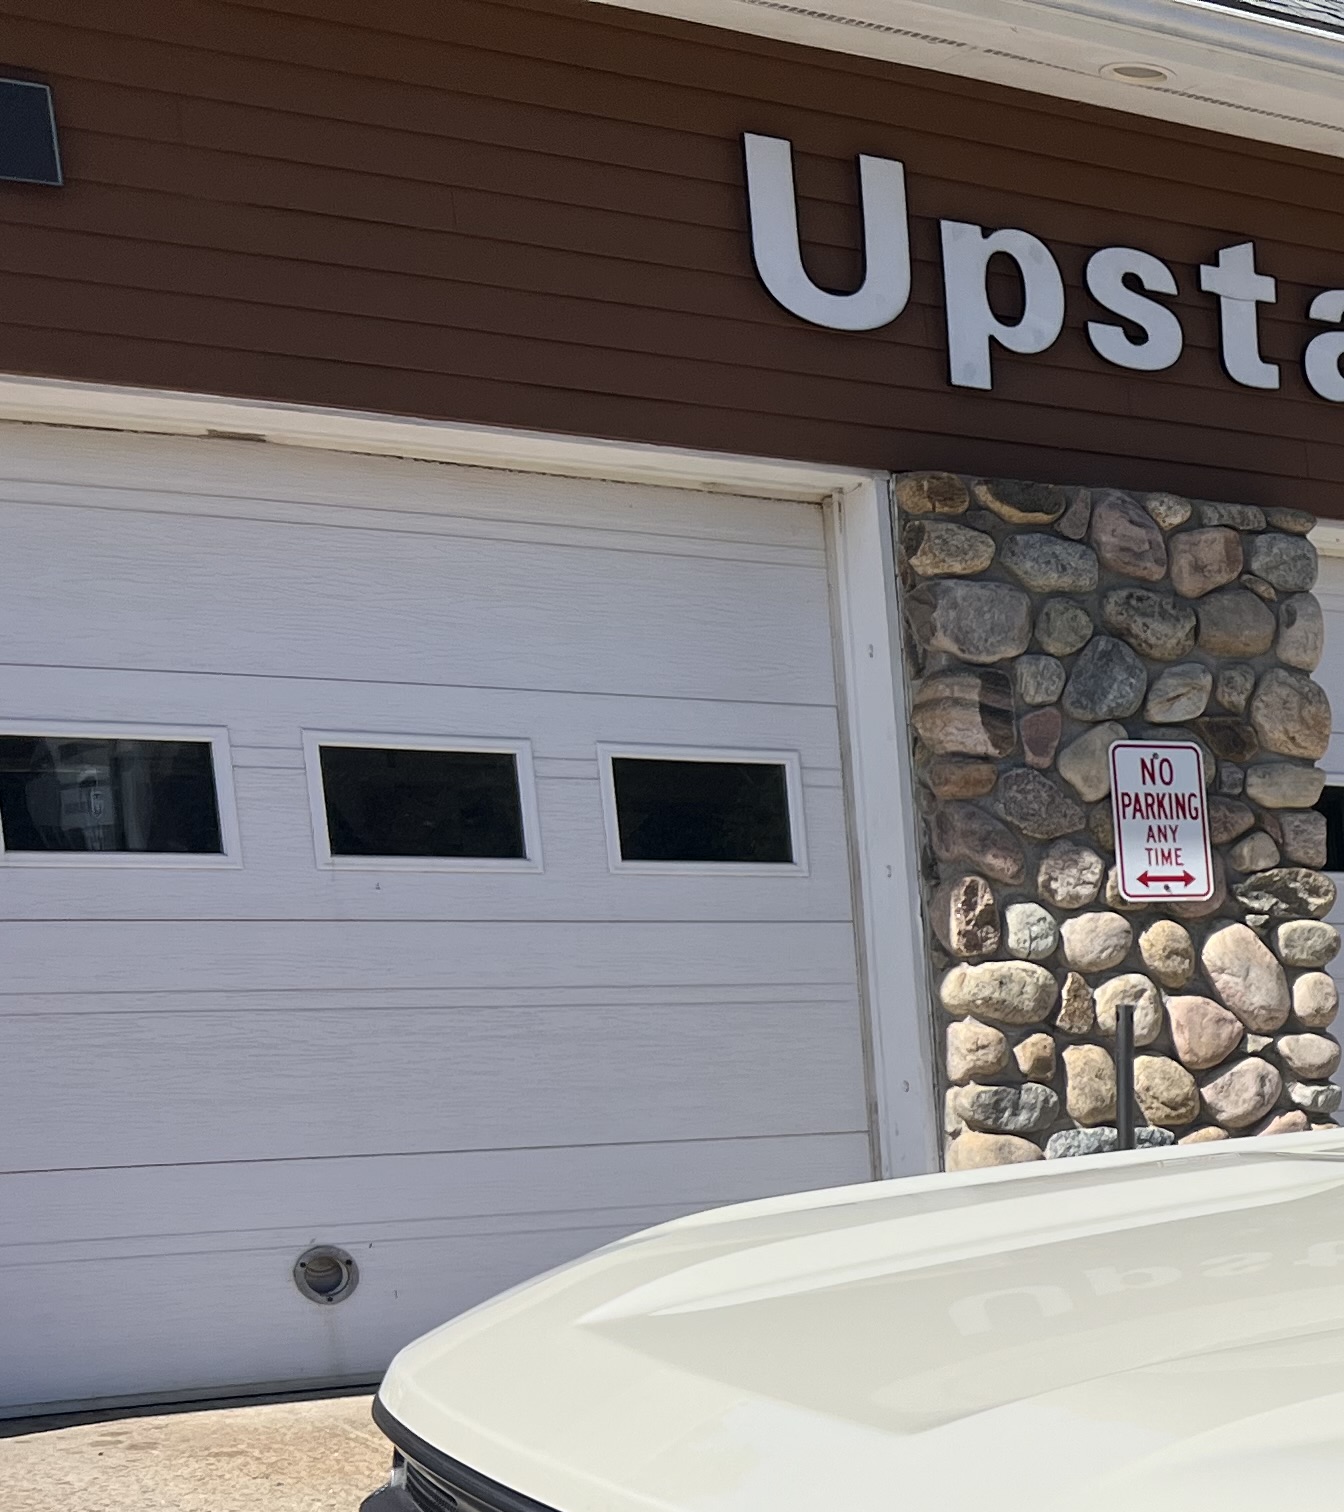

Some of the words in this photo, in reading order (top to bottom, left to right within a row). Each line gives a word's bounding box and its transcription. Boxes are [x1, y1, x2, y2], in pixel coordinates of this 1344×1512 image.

[1140, 757, 1174, 786] NO
[1121, 792, 1199, 820] PARKING
[1146, 824, 1179, 843] ANY
[1145, 847, 1184, 867] TIME
